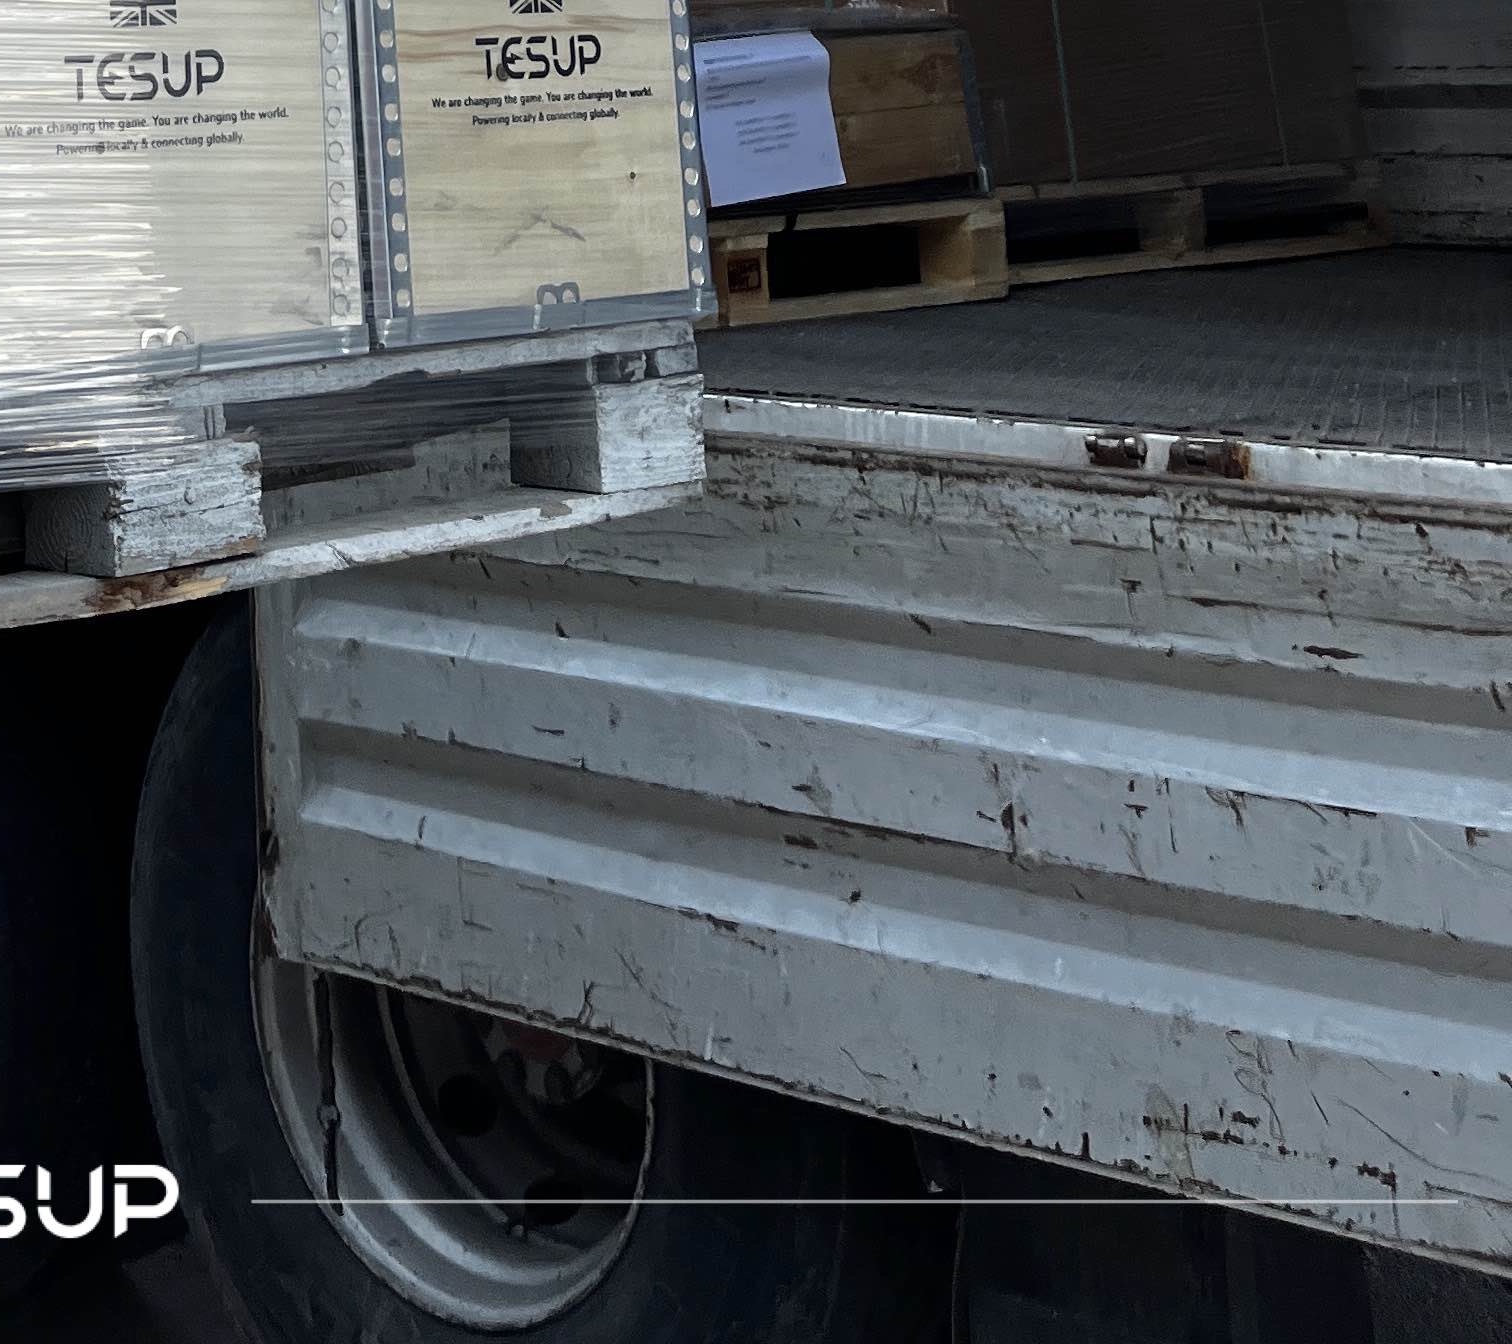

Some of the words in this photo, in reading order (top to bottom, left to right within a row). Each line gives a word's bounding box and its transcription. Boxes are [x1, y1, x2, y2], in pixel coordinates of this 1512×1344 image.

[475, 34, 601, 80] TESUP
[64, 49, 224, 101] TESUP
[432, 97, 446, 108] We
[448, 99, 461, 107] are
[464, 96, 502, 108] changing
[504, 94, 517, 104] the
[520, 94, 544, 106] game.
[546, 91, 561, 102] You
[564, 93, 575, 101] are
[578, 90, 613, 101] changing
[615, 88, 627, 98] the
[628, 86, 653, 97] world.
[5, 124, 22, 138] We
[26, 125, 43, 136] are
[47, 121, 96, 135] changing
[98, 119, 115, 131] the
[152, 114, 170, 126] You
[174, 116, 188, 125] are
[193, 112, 237, 125] changing
[240, 109, 255, 121] the
[258, 106, 289, 119] world.
[472, 115, 510, 126] Powering
[512, 114, 536, 123] locally
[538, 112, 544, 121] &
[546, 112, 587, 121] connecting
[141, 138, 148, 149] &
[151, 135, 204, 149] connecting
[206, 132, 245, 147] globally.
